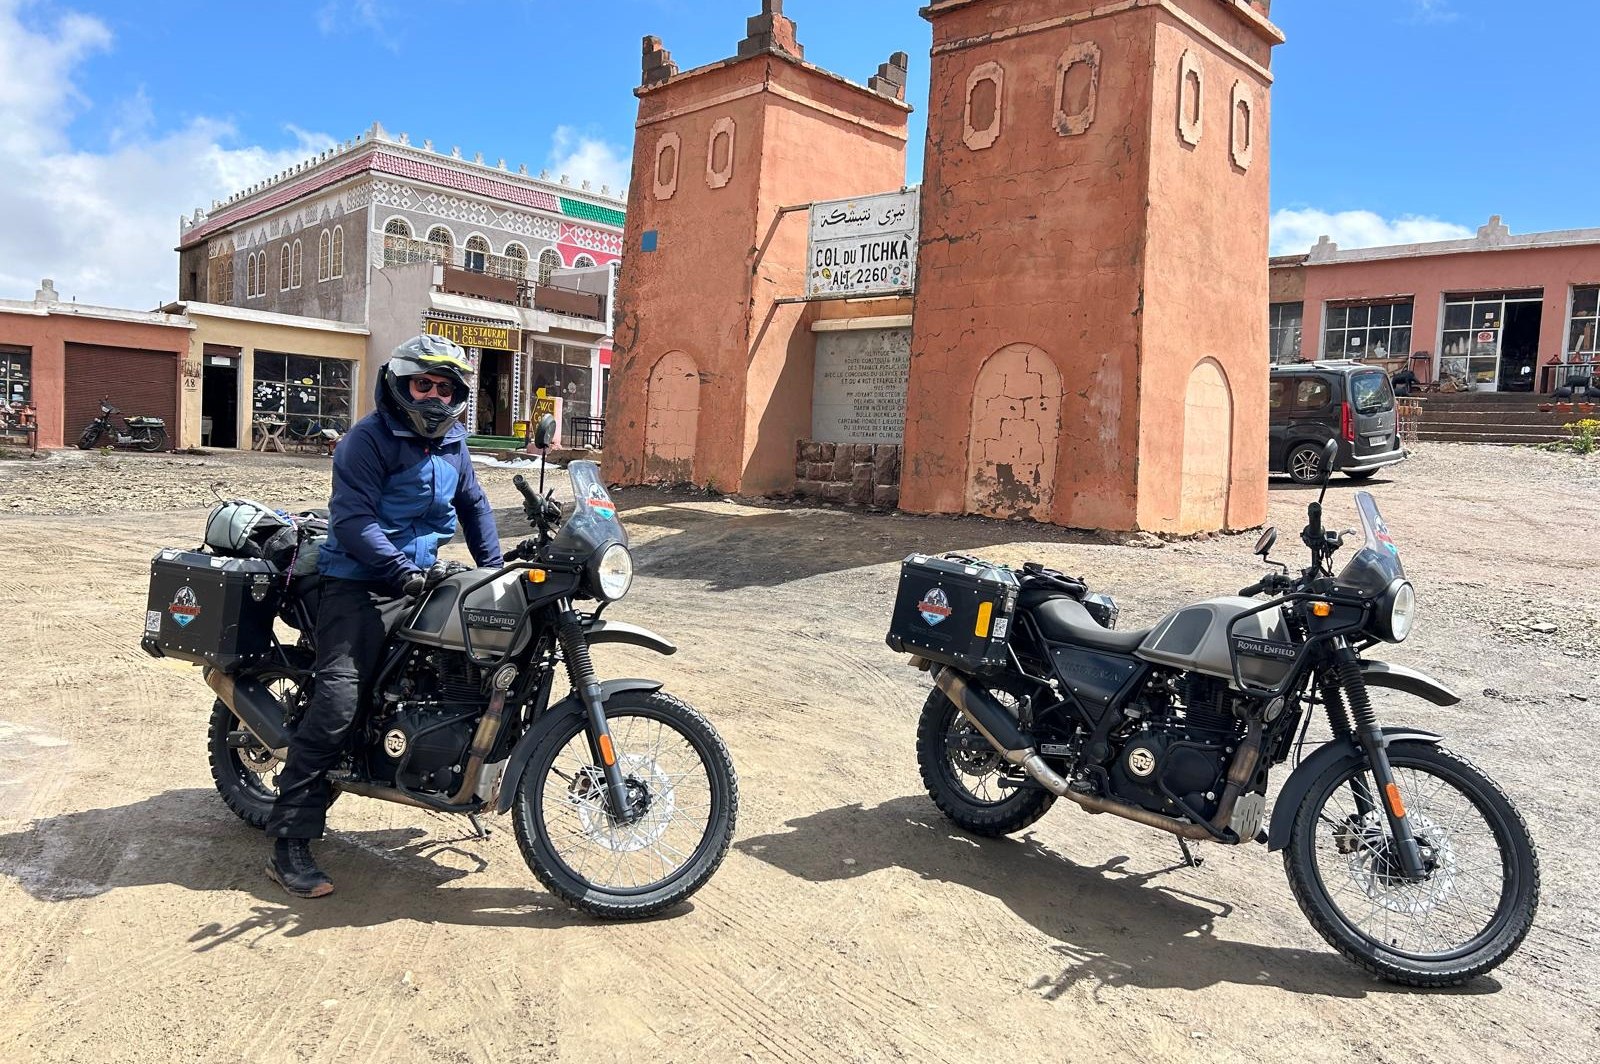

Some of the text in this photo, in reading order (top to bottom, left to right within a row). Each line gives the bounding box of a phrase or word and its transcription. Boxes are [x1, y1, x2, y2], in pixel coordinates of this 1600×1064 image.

[815, 240, 909, 268] COL DU TICHKA
[856, 266, 888, 284] 2260
[429, 322, 507, 343] CAFE RESTAURAN
[461, 335, 477, 345] COL
[468, 613, 516, 626] ROYAL ENFIELD
[1237, 641, 1296, 657] ROYAL ENFIELD
